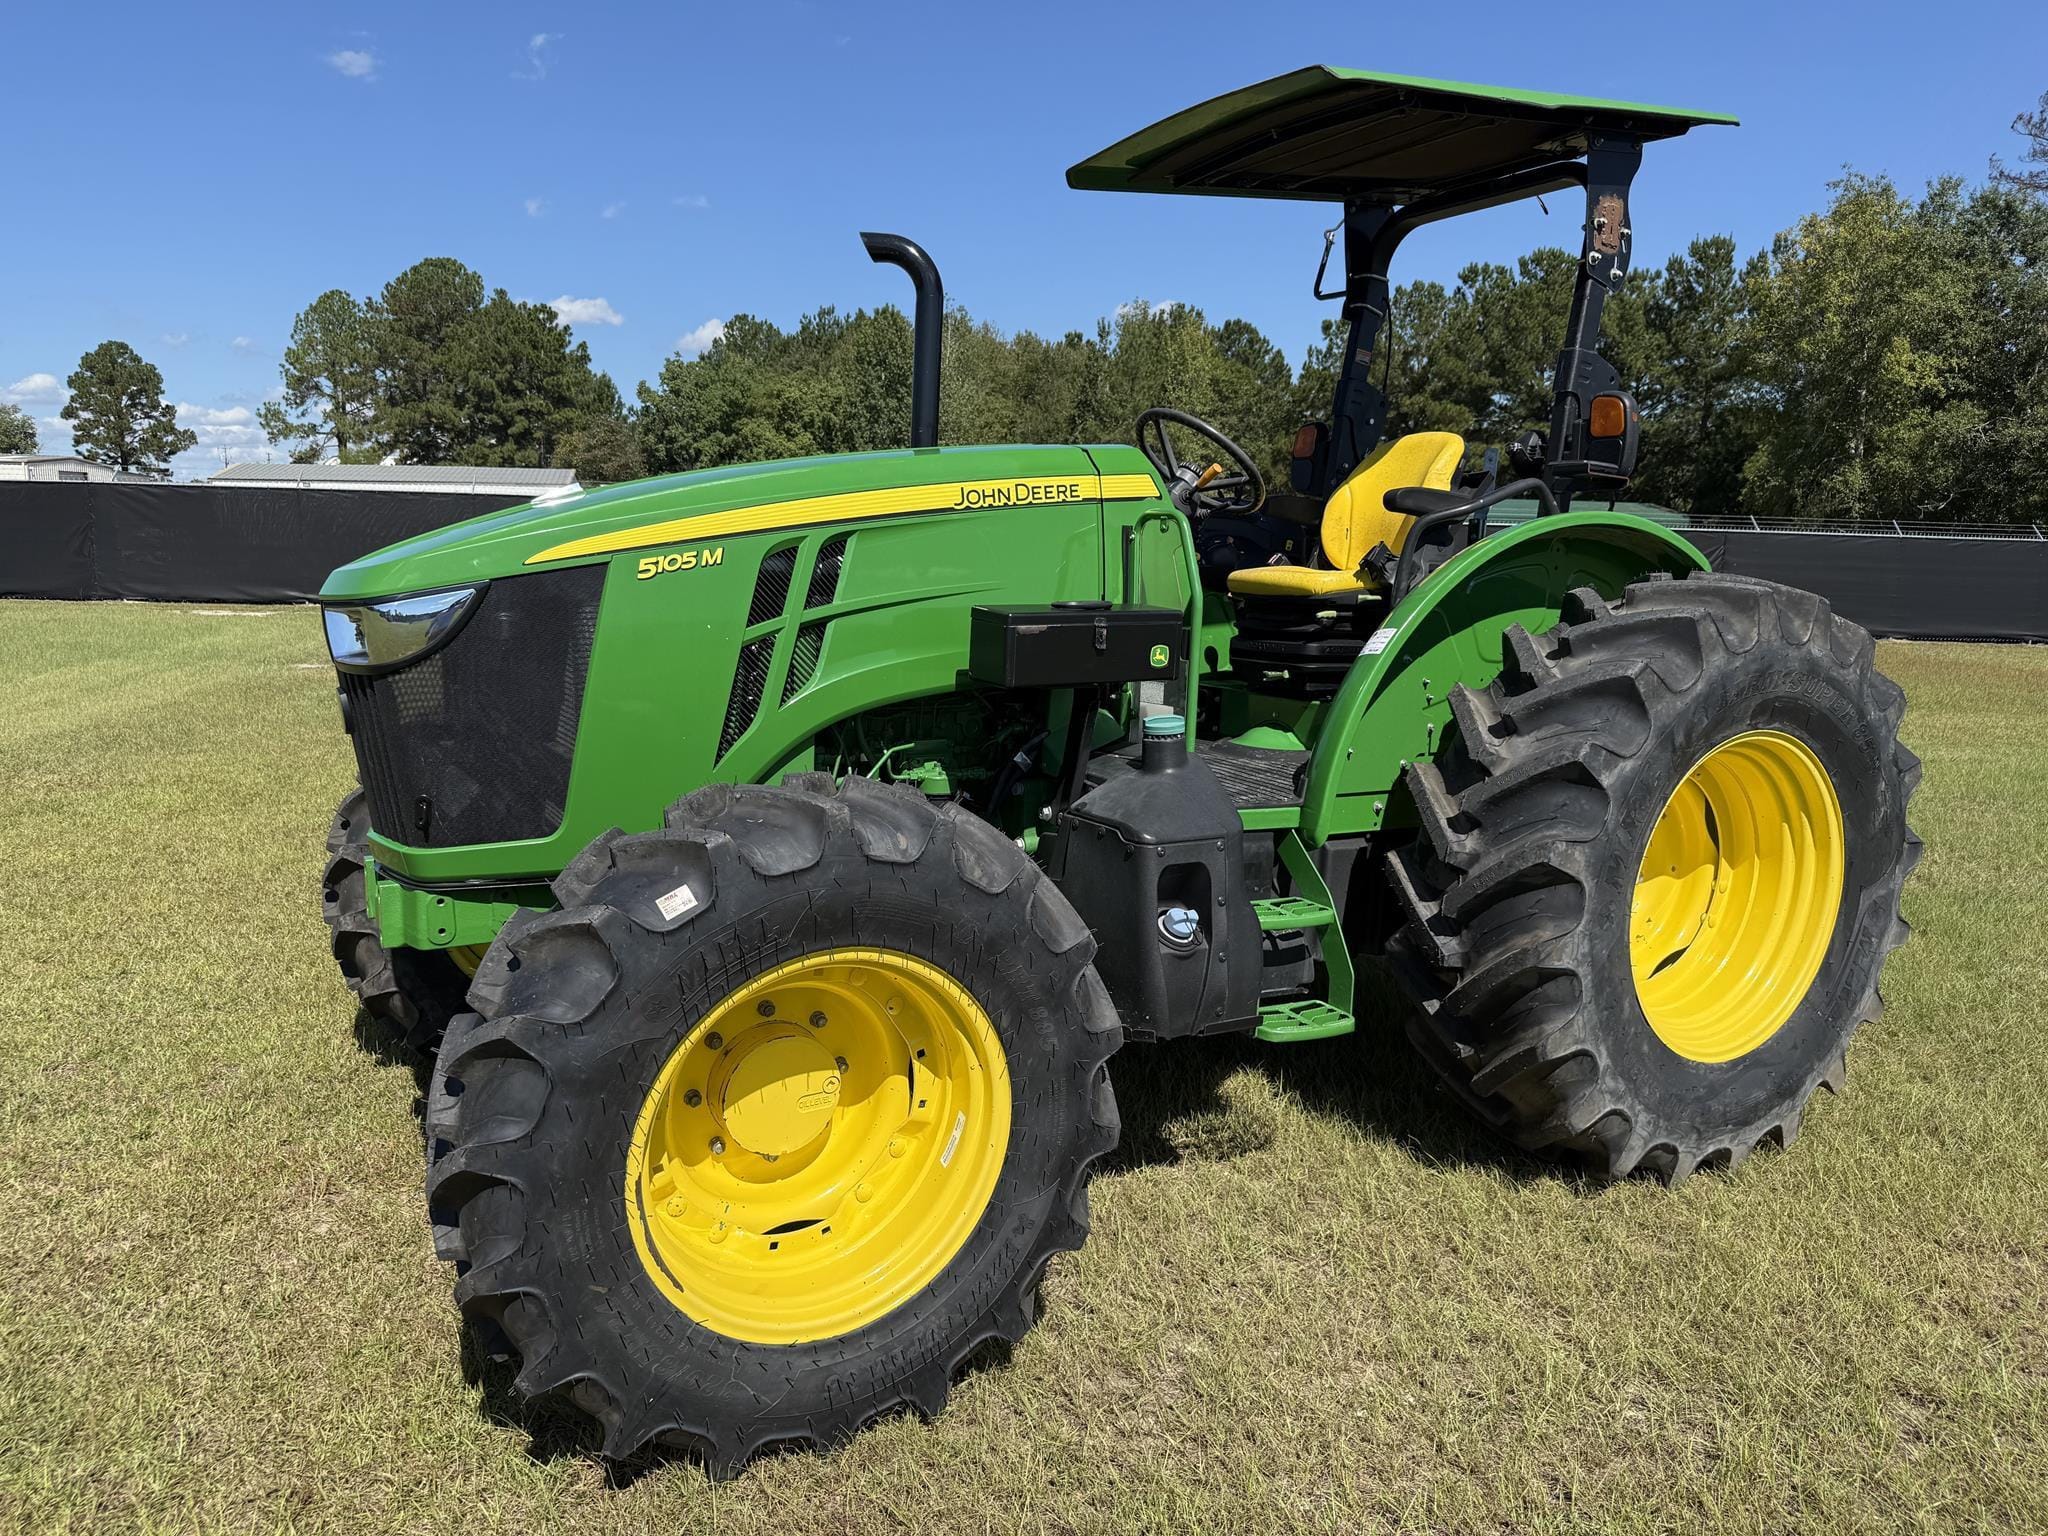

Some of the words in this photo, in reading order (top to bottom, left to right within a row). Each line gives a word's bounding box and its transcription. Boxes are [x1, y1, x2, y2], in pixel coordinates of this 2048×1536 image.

[953, 486, 1011, 507] JOHN
[1015, 483, 1080, 502] DEERE
[637, 551, 698, 580] 5105
[701, 547, 724, 568] M
